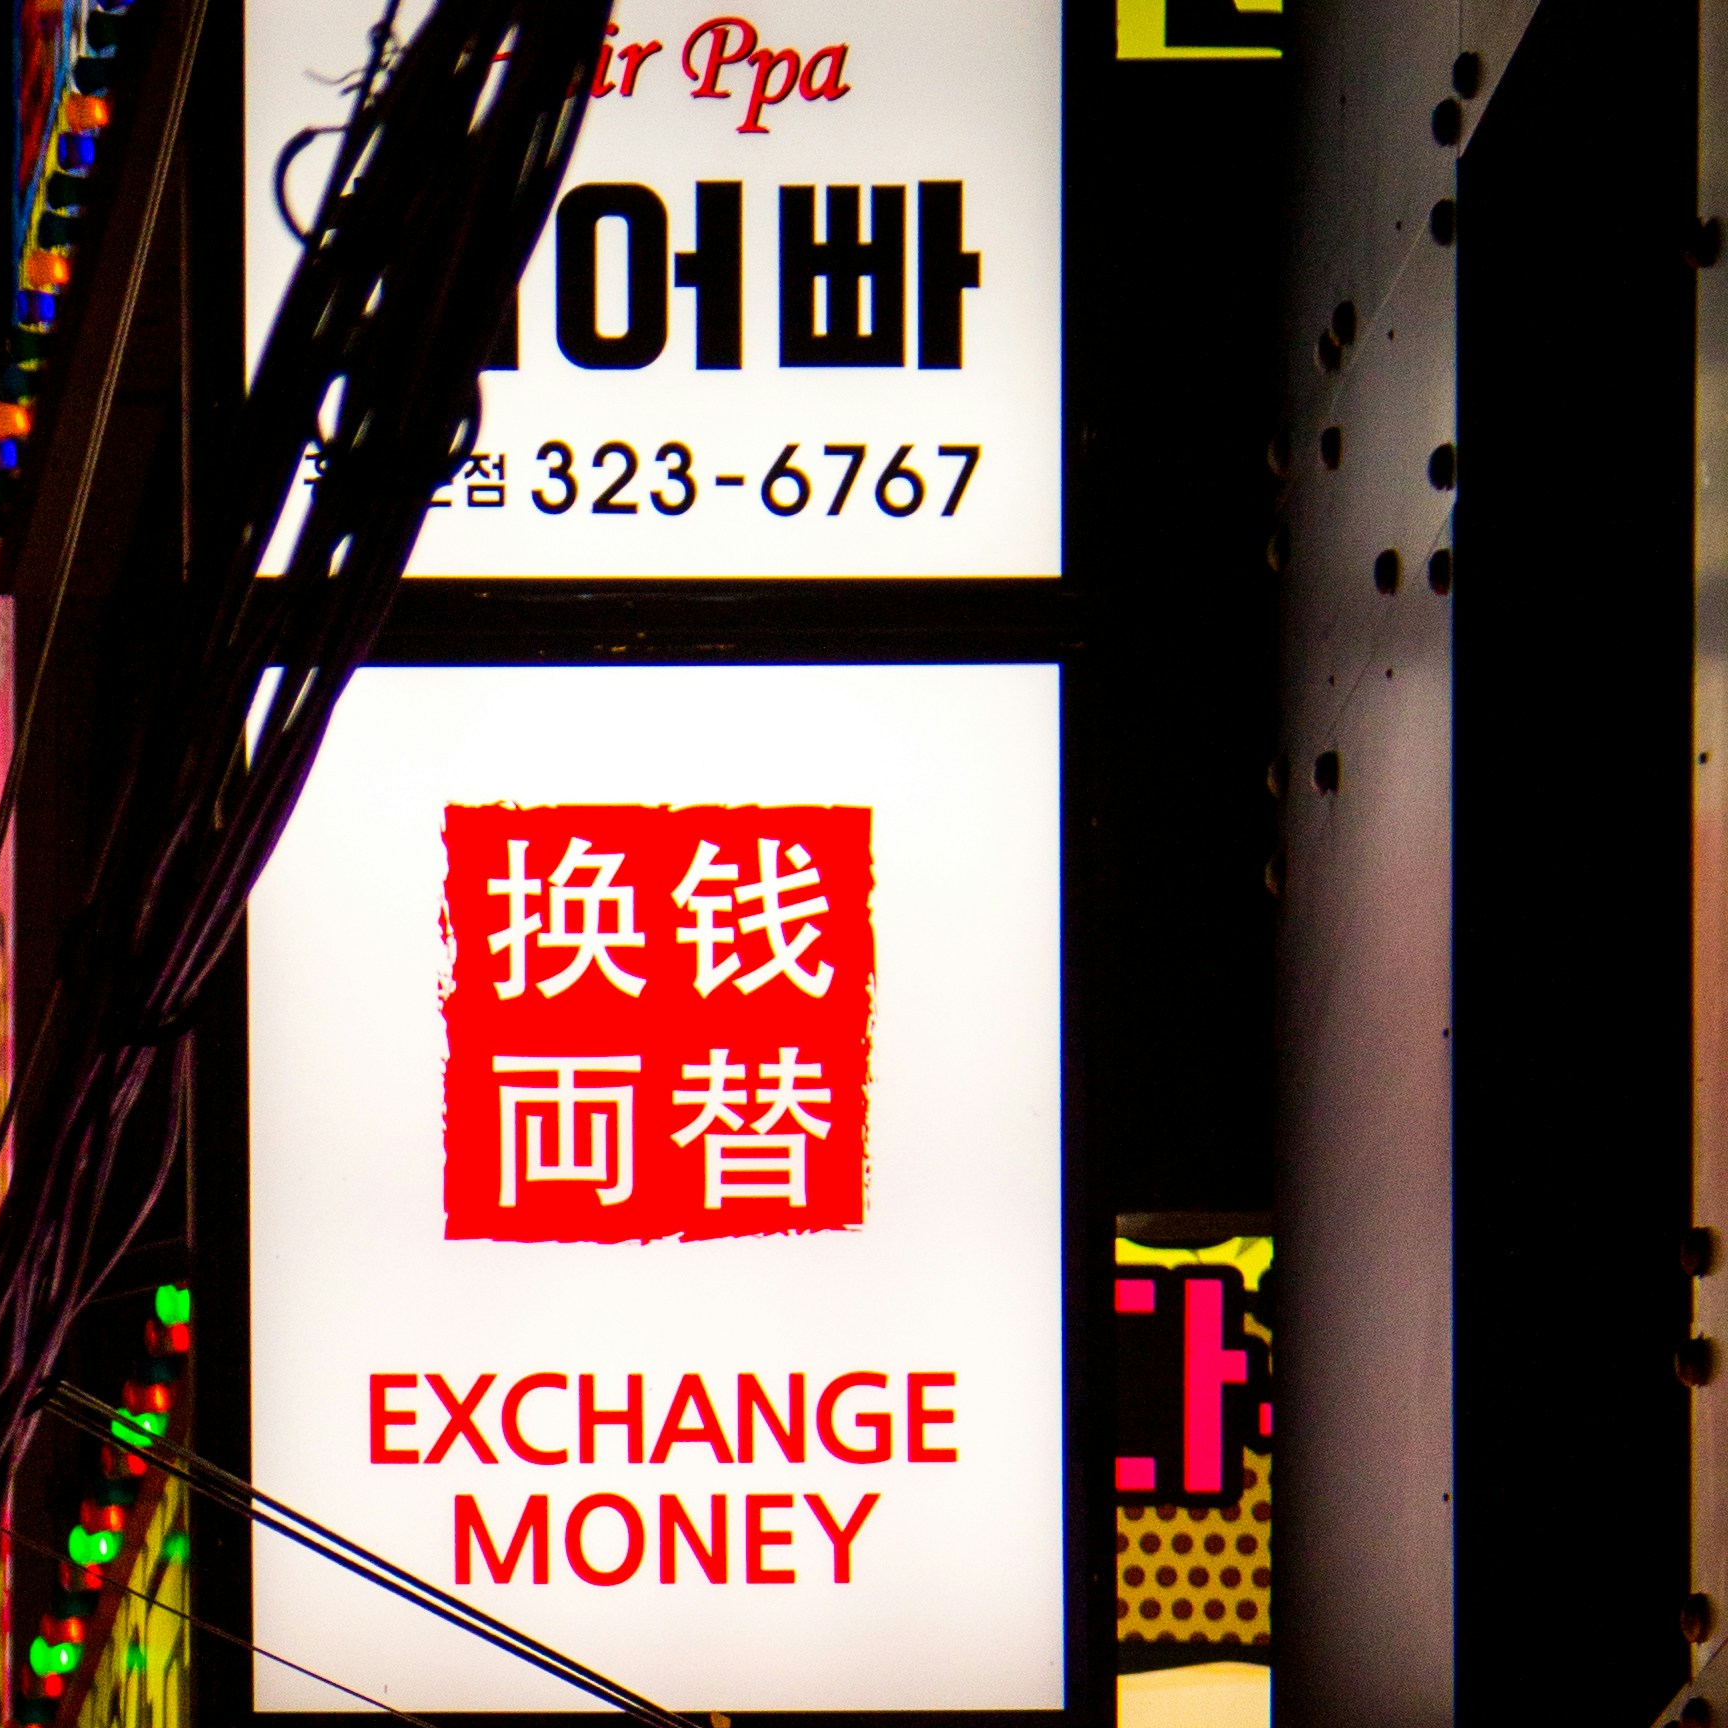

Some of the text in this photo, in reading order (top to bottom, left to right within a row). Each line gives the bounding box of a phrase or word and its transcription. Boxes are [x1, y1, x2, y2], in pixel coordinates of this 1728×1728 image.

[682, 16, 850, 134] Ppa
[531, 440, 983, 518] 323-6767
[487, 836, 836, 1000] 换钱
[491, 1046, 833, 1210] 両替
[368, 1371, 959, 1466] EXCHANGE
[454, 1492, 881, 1586] MONEY
